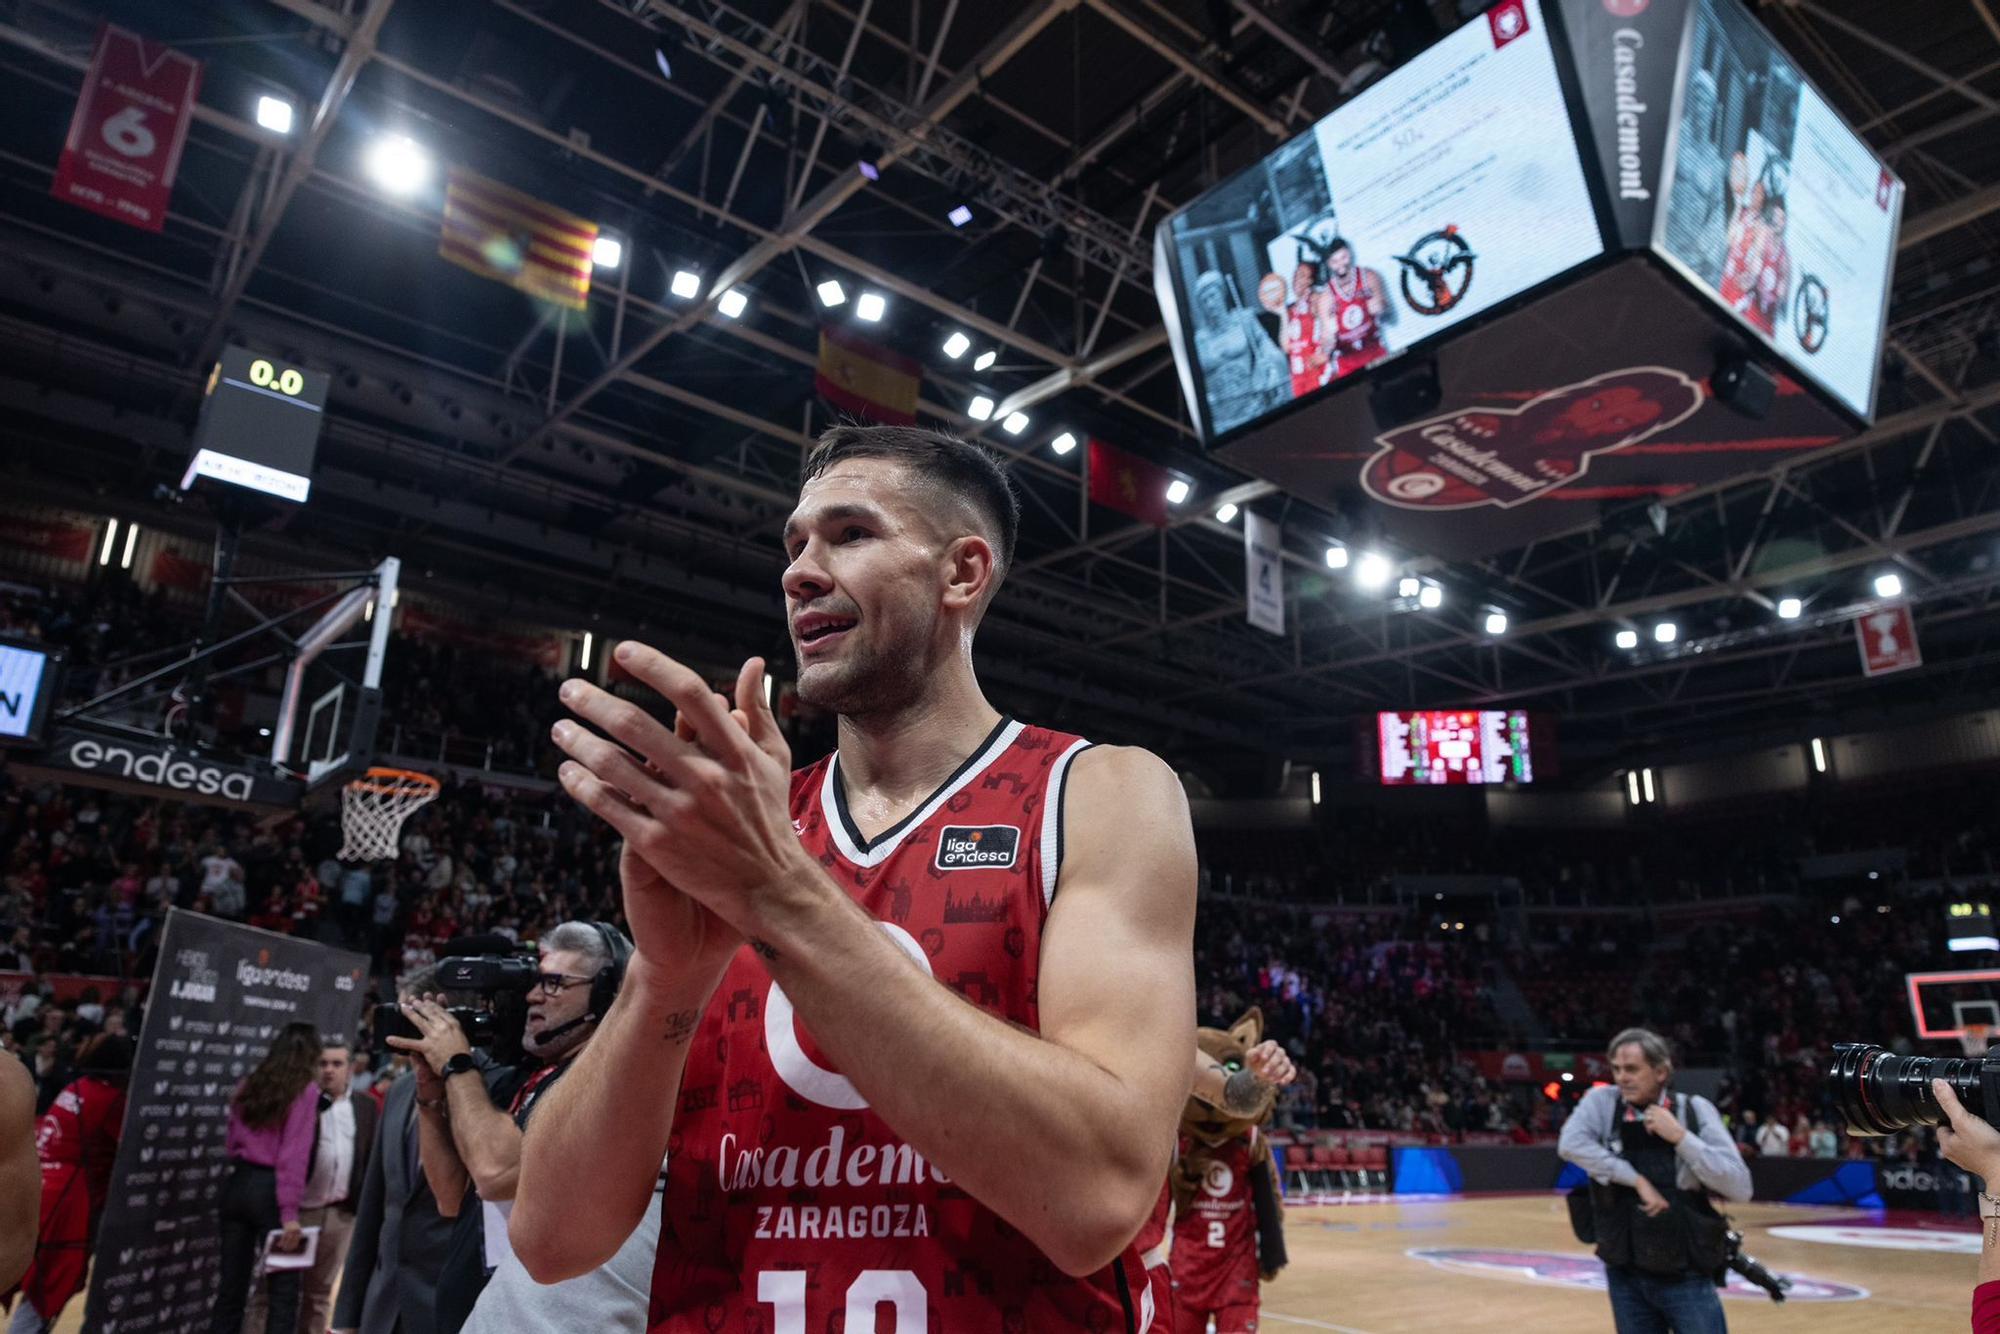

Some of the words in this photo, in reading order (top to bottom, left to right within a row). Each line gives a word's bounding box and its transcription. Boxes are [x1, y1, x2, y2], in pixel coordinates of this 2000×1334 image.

[102, 107, 156, 158] 6
[1613, 28, 1650, 200] Casademont
[249, 359, 304, 396] 0.0
[1420, 424, 1548, 492] Casademont
[70, 740, 254, 801] endesa
[944, 850, 1010, 864] endesa
[946, 838, 977, 853] liga
[754, 1204, 928, 1239] ZARAGOZA
[1207, 1221, 1226, 1248] 2
